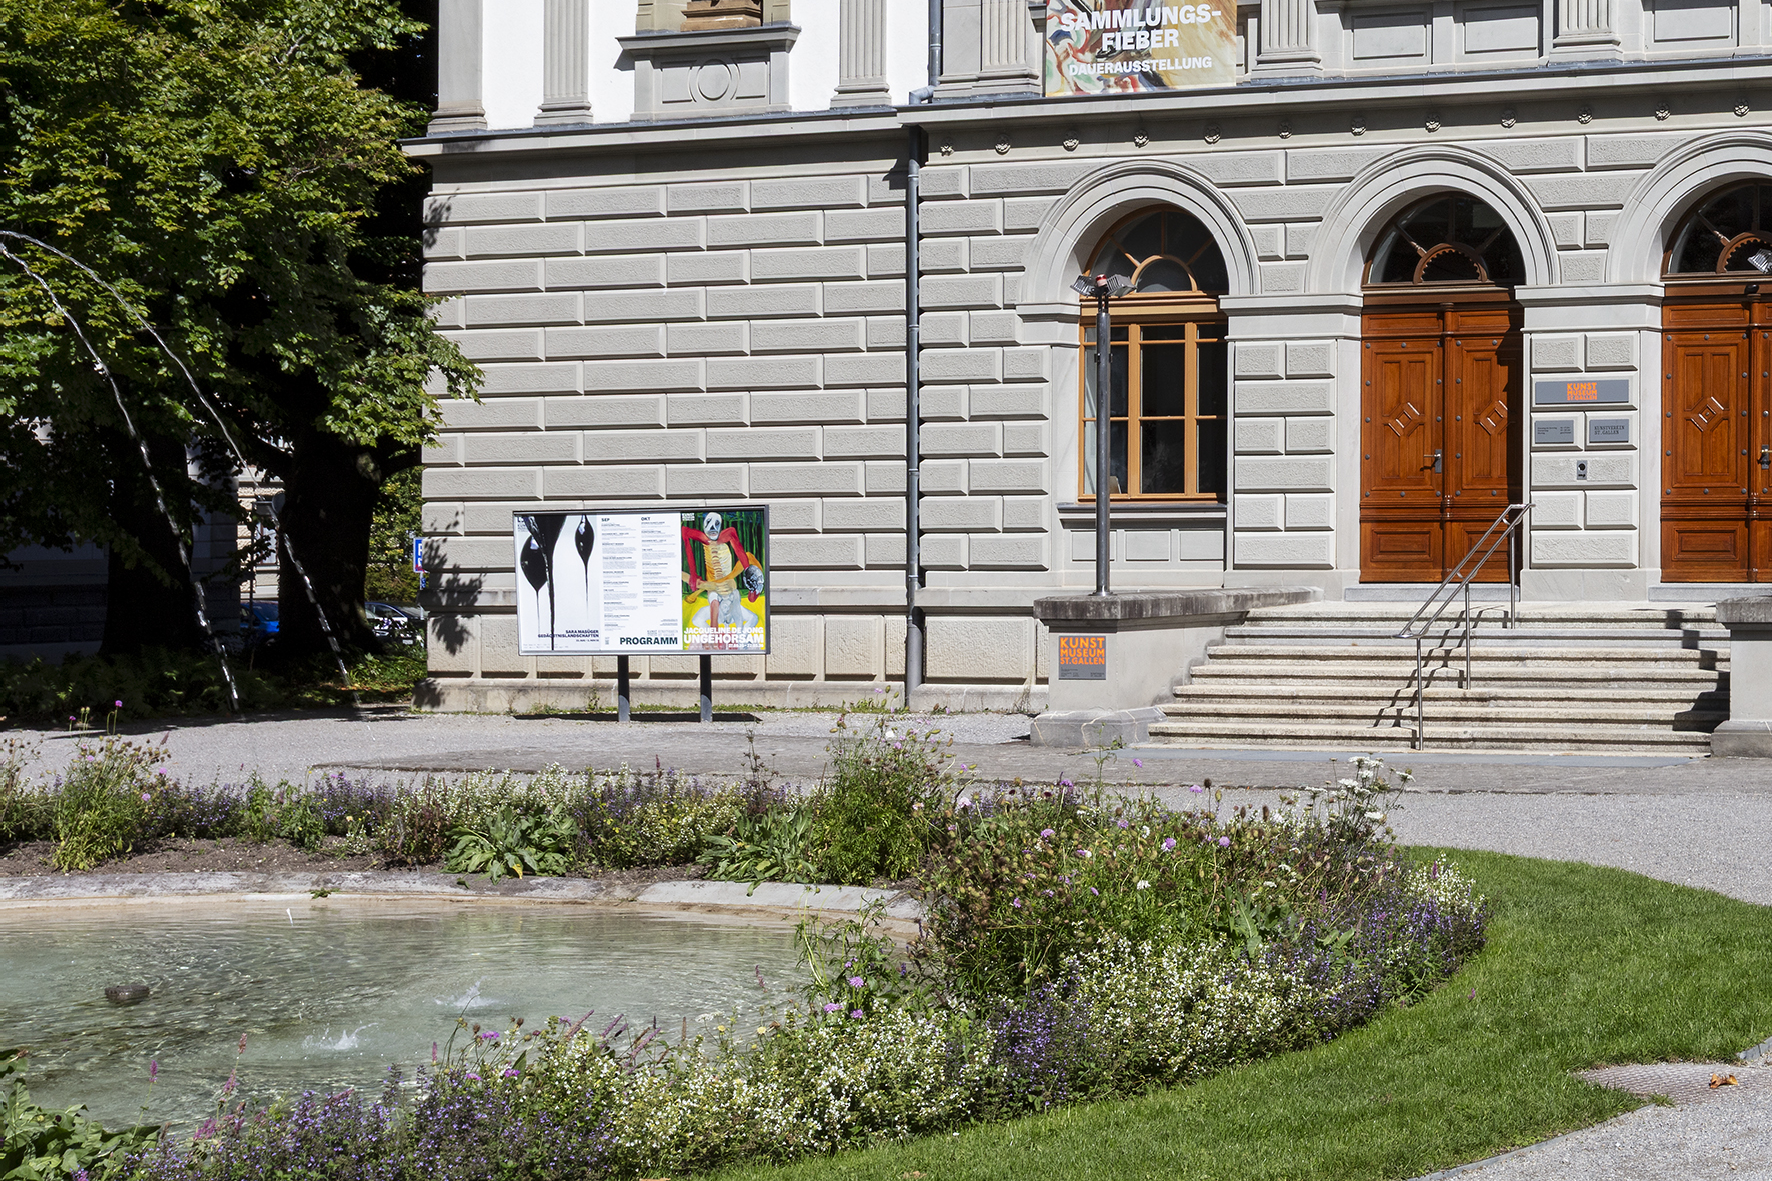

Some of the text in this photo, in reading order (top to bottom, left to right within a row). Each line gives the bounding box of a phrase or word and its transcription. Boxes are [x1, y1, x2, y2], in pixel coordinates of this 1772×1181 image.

[1061, 3, 1222, 31] SAMMLUNGS-
[1101, 29, 1180, 51] FIEBER
[1069, 56, 1212, 76] DAUERAUSSTELLUNG
[1567, 382, 1597, 390] KUNST
[619, 637, 678, 645] PROGRAMM
[683, 634, 764, 644] UNGEHORSAM
[1060, 637, 1105, 648] KUNST
[1060, 648, 1105, 657] MUSEUM
